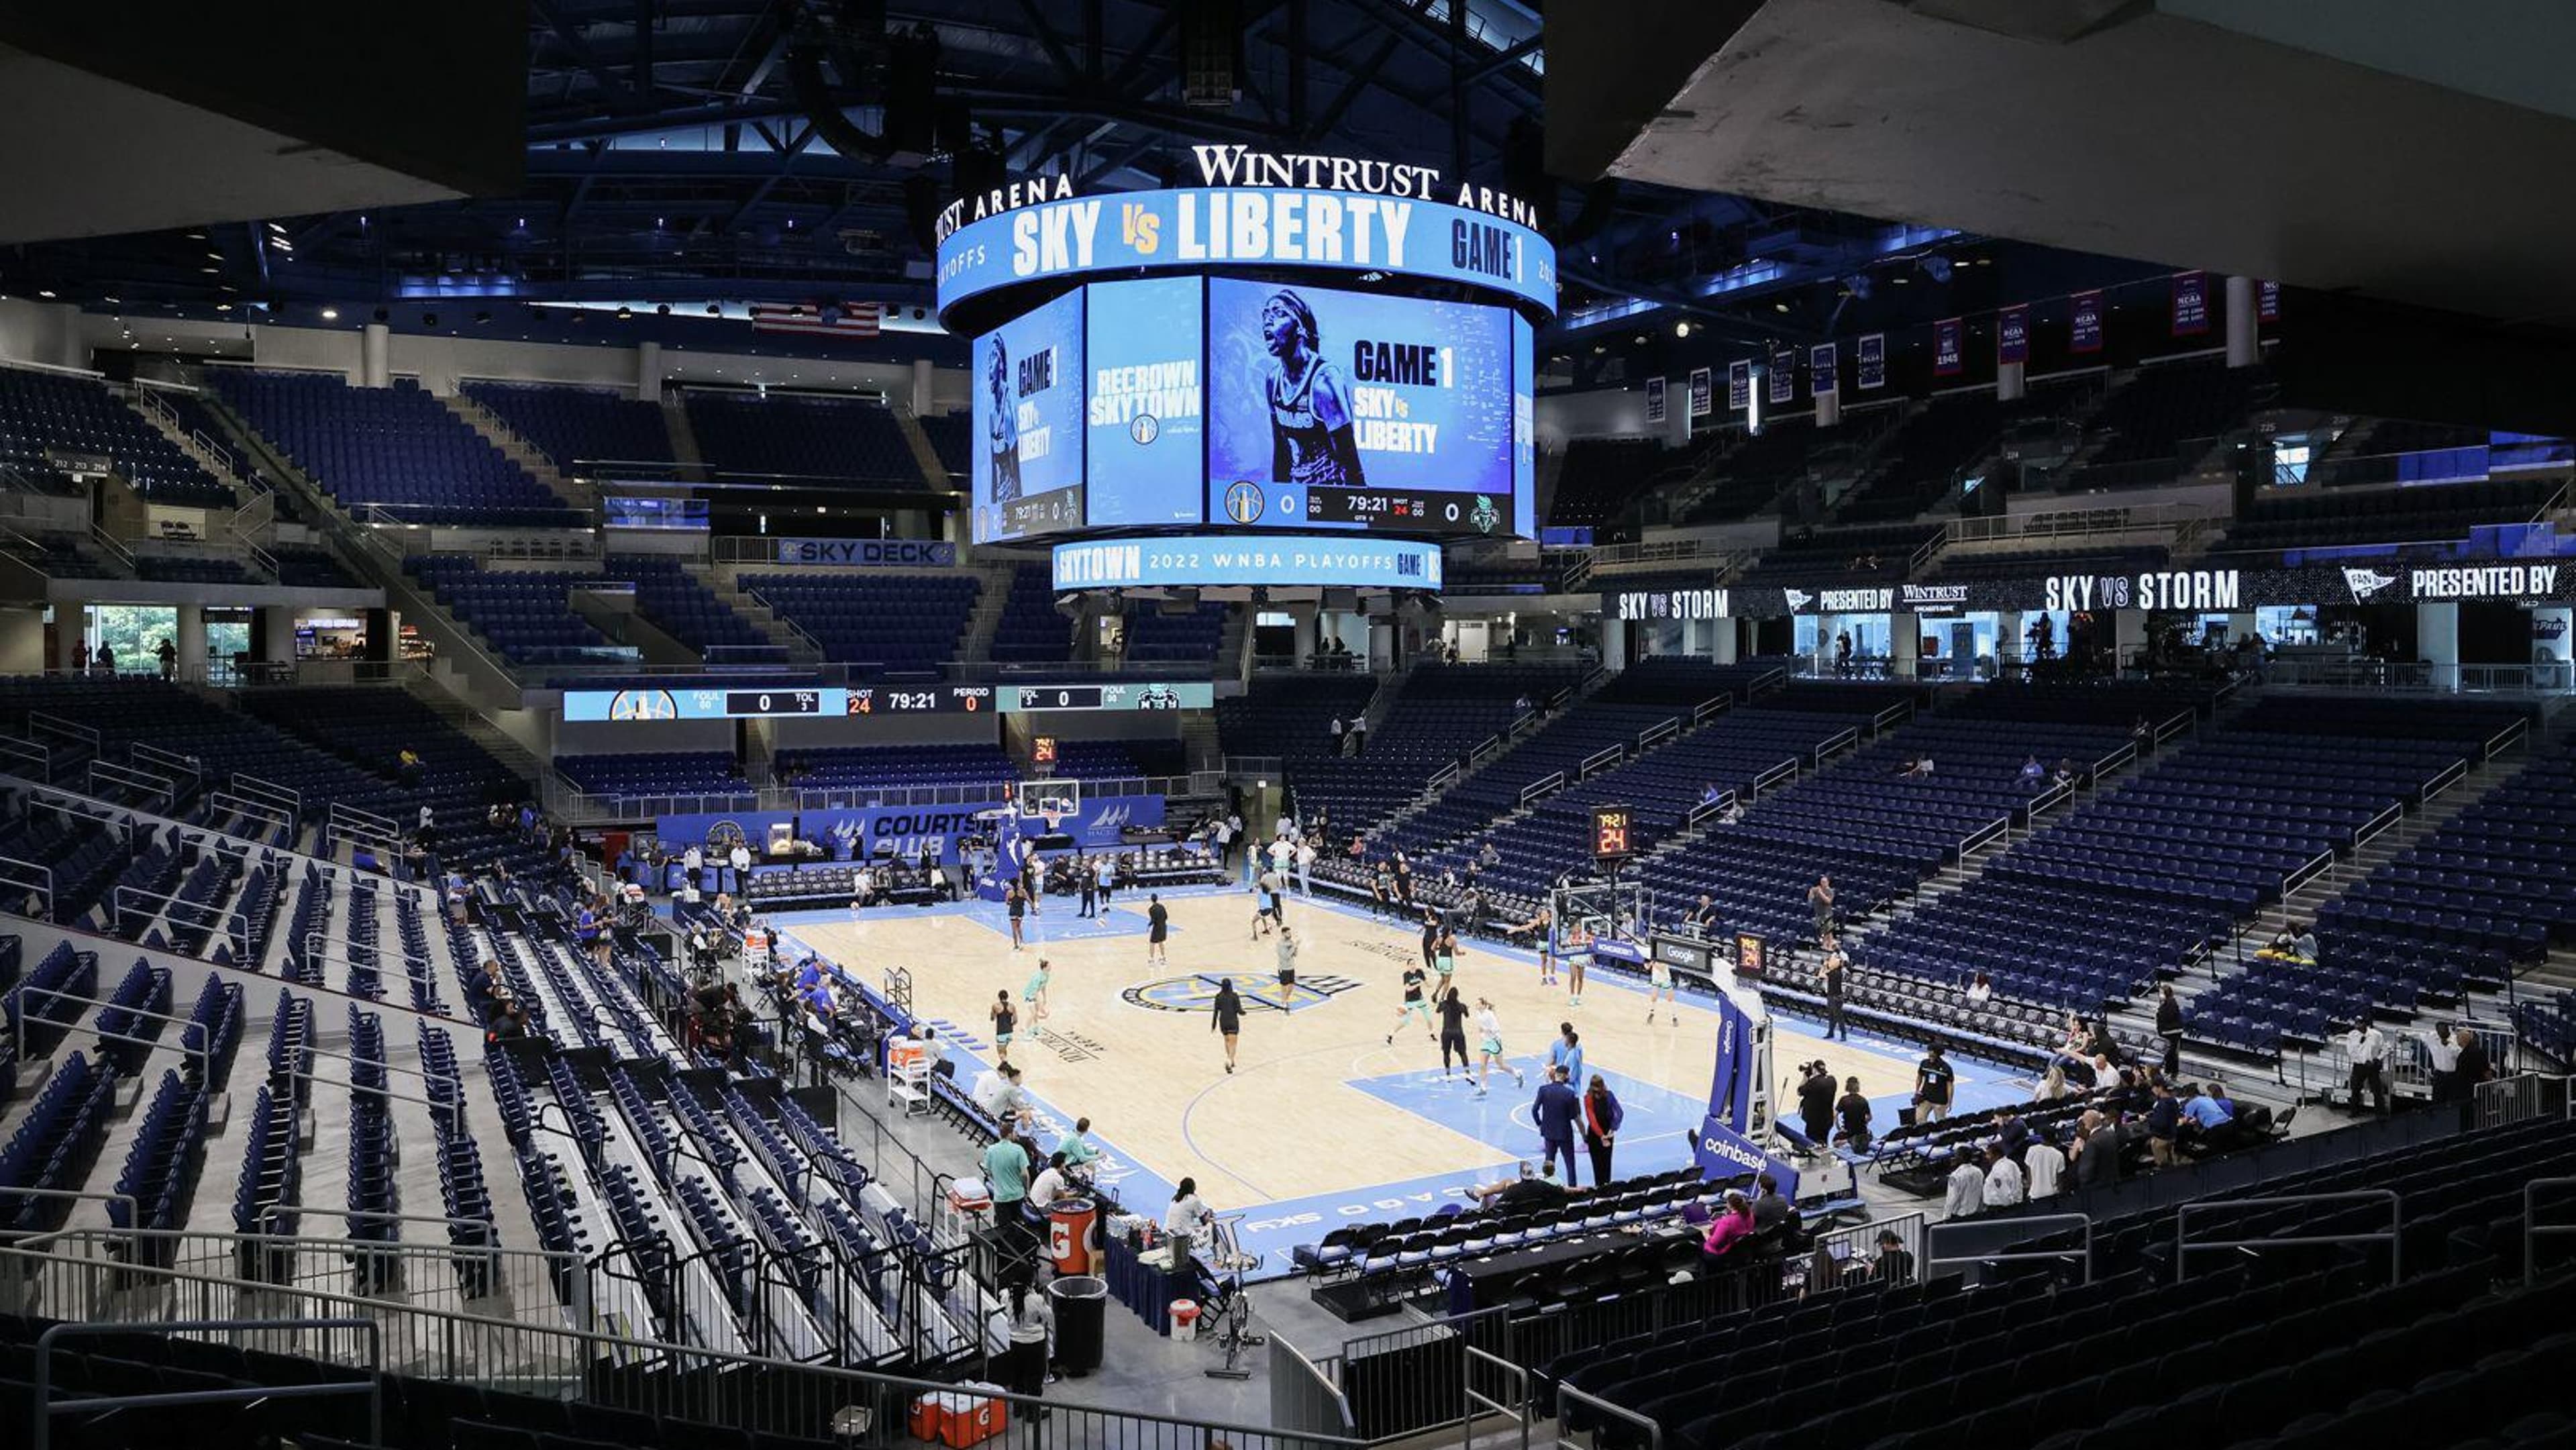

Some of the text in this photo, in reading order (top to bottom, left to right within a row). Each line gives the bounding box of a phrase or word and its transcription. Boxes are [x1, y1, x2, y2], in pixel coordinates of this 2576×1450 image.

[974, 172, 1073, 221] ARENA
[1192, 144, 1538, 231] WINTRUST ARENA
[1013, 200, 1101, 277] SKY
[1178, 193, 1412, 267] LIBERTY
[1451, 218, 1523, 284] GAME 1
[1019, 344, 1058, 398] GAME 1
[1355, 340, 1453, 389] GAME 1
[1097, 360, 1196, 395] RECROWN
[1090, 385, 1200, 427] SKYTOWN
[1354, 387, 1395, 418] SKY
[1017, 425, 1051, 463] LIBERTY
[1354, 419, 1438, 454] LIBERTY
[1280, 495, 1295, 513] 0
[1348, 495, 1387, 511] 79:21
[1445, 503, 1459, 521] 0
[801, 542, 936, 562] SKY DECK
[1060, 546, 1139, 582] SKYTOWN
[1151, 555, 1199, 569] 2022
[1213, 553, 1280, 568] WNBA
[1296, 554, 1392, 570] PLAYOFFS
[1397, 553, 1421, 576] GAME
[1903, 584, 1967, 599] WINTRUST
[2046, 570, 2238, 611] SKY VS STORM
[2412, 566, 2557, 597] PRESENTED BY
[1619, 590, 1728, 619] SKY VS STORM
[1820, 589, 1877, 610] PRESENTED
[1879, 588, 1894, 609] BY
[759, 694, 770, 711] 0
[794, 693, 814, 703] TOL
[847, 690, 873, 698] SHOT
[889, 693, 935, 708] 79:21
[954, 688, 989, 697] PERIOD
[966, 696, 977, 711] 0
[1021, 689, 1038, 698] TOL
[1058, 691, 1070, 707] 0
[849, 698, 870, 713] 24
[1037, 747, 1052, 760] 24
[1601, 829, 1625, 852] 24
[1667, 945, 1695, 962] Google
[1705, 1138, 1767, 1172] coinbase
